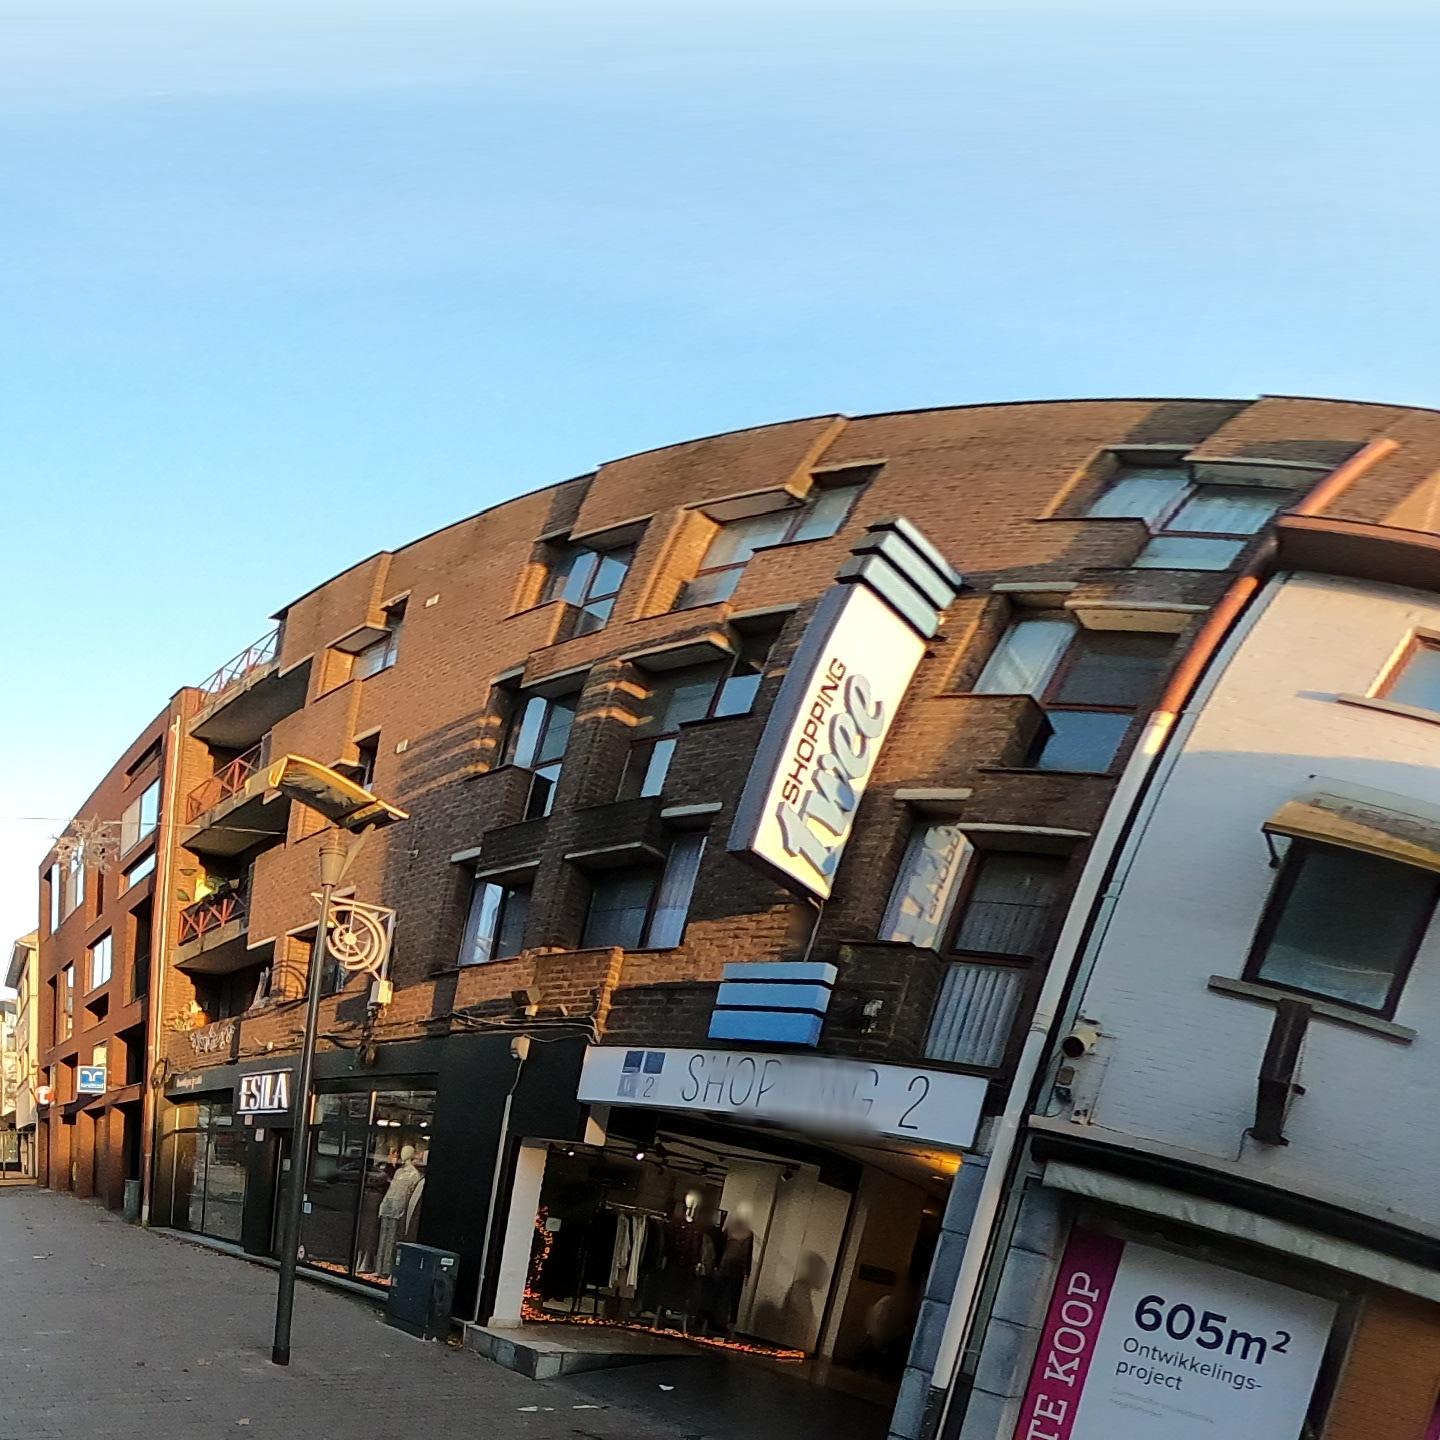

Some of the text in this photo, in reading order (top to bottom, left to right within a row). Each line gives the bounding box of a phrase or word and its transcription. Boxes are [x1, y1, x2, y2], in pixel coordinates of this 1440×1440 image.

[781, 657, 846, 805] SHOPPING
[897, 1075, 931, 1130] 2
[1044, 1271, 1100, 1387] KOOP
[1116, 1360, 1184, 1391] project
[1123, 1337, 1263, 1391] Ontwikkelings-
